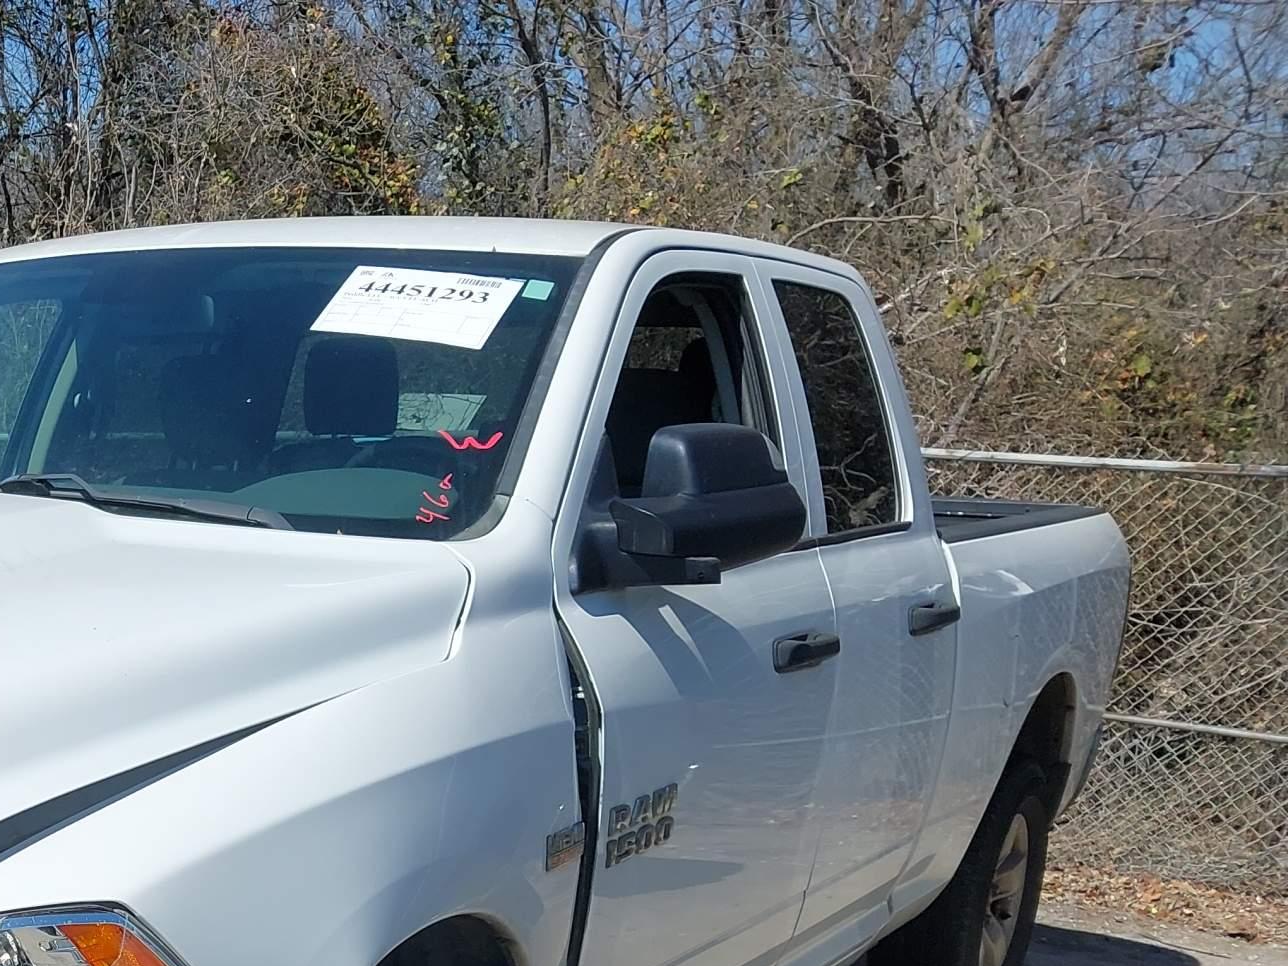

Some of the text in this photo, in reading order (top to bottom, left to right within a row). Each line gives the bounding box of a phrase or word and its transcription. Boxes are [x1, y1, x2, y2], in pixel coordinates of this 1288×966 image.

[358, 281, 490, 304] 44451293
[608, 782, 678, 837] RAM
[605, 816, 674, 868] 1500
